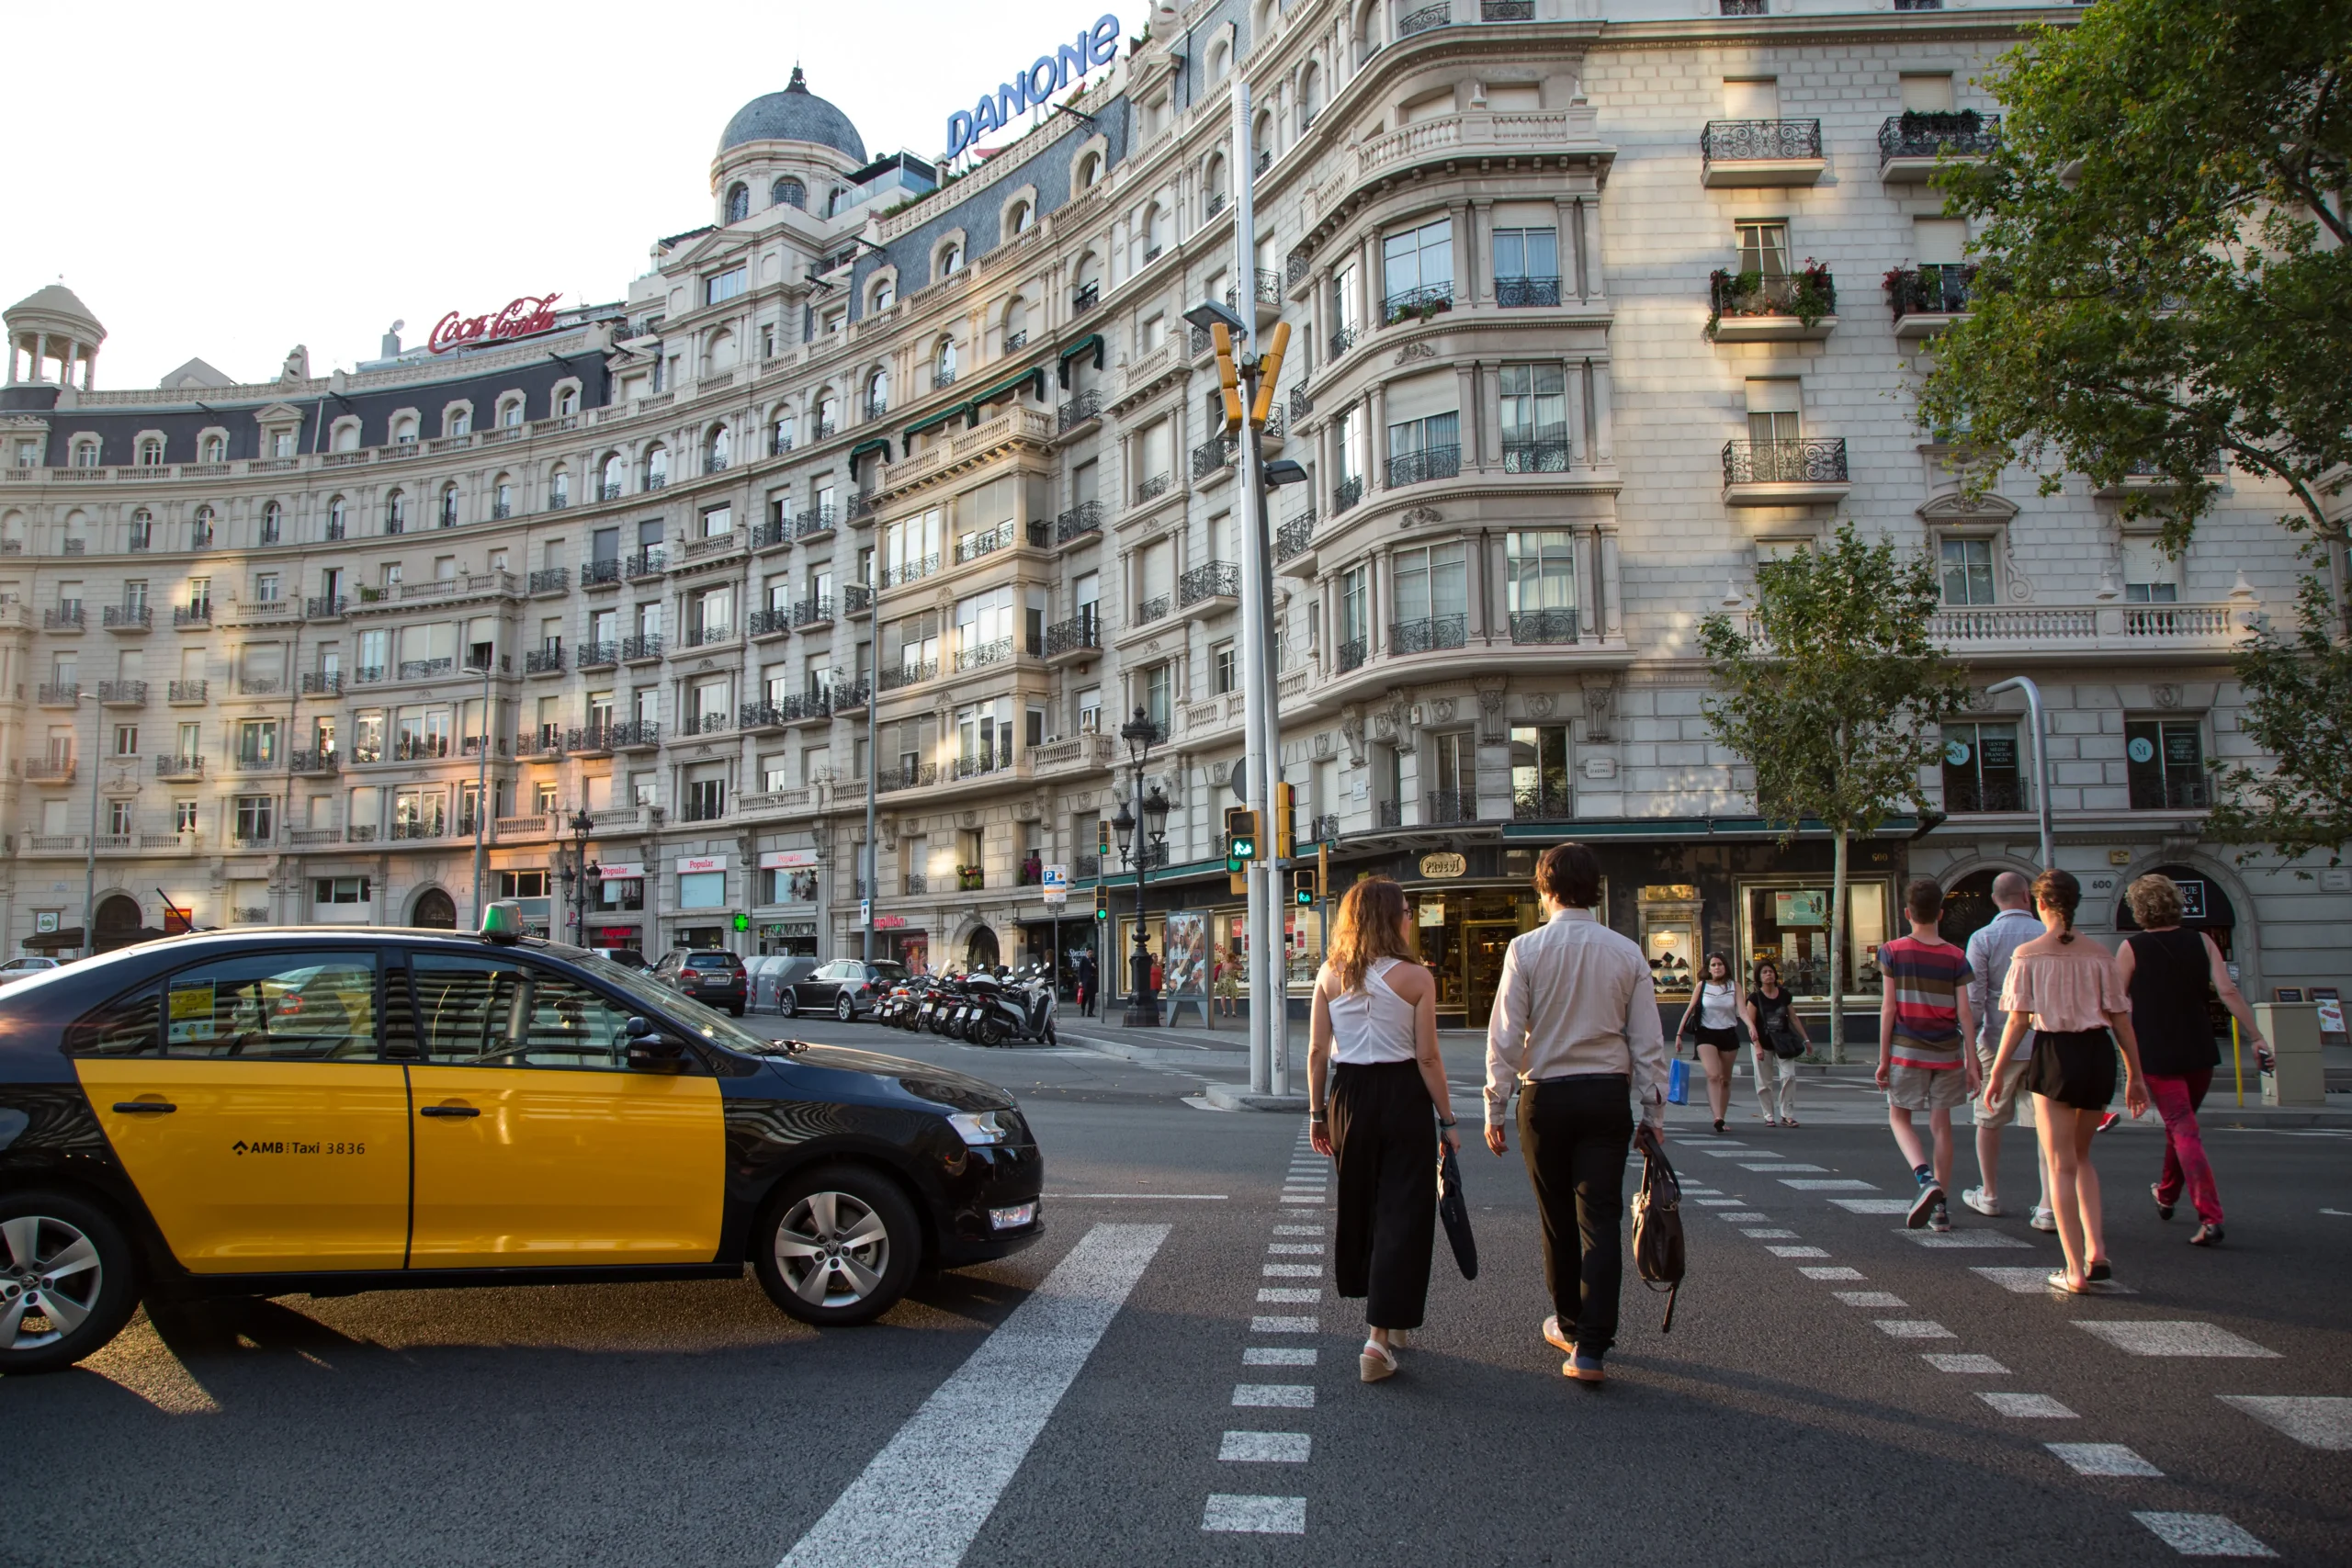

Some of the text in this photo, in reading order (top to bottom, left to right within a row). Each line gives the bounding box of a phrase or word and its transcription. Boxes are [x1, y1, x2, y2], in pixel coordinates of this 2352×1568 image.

[427, 292, 563, 354] Coca-Cola
[777, 852, 802, 863] Popular
[1871, 852, 1888, 862] 600
[689, 859, 714, 870] Popular
[603, 866, 628, 876] Popular
[2092, 880, 2112, 889] 600
[874, 915, 905, 930] mplifon
[602, 926, 632, 937] Popular
[764, 923, 818, 938] FARMACIA
[1069, 947, 1087, 959] Special
[250, 1141, 366, 1155] AMB Taxi 3836
